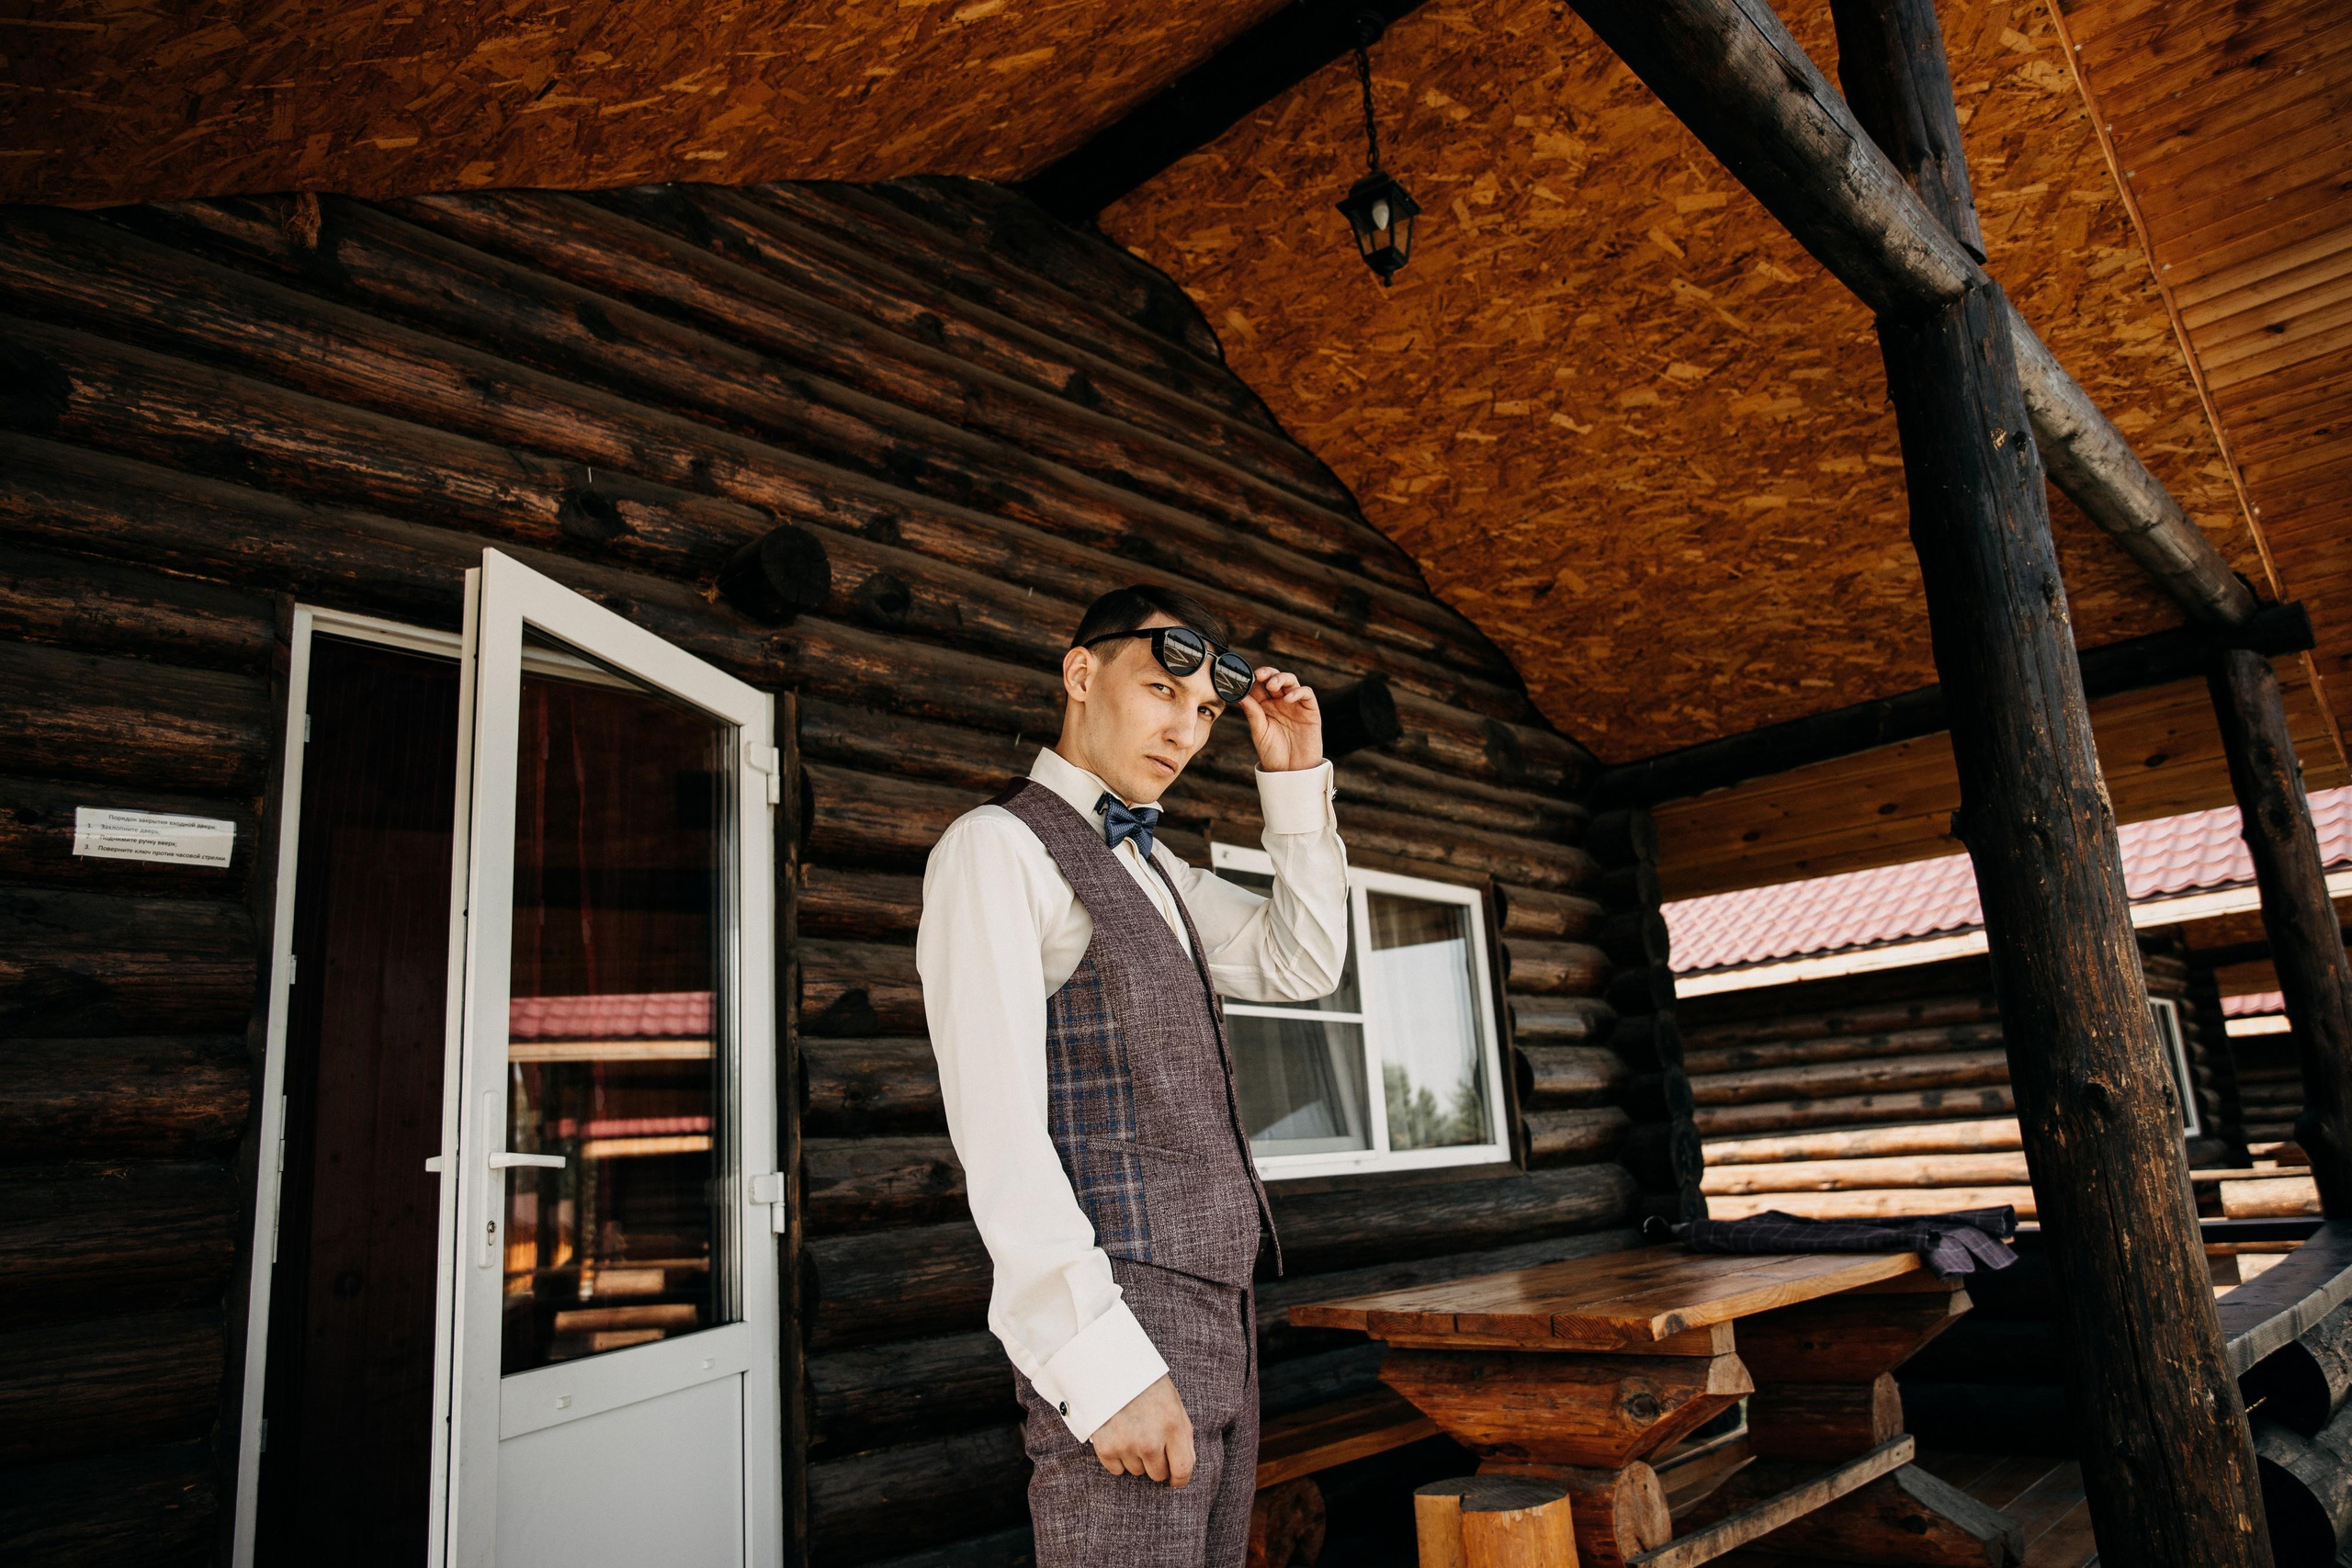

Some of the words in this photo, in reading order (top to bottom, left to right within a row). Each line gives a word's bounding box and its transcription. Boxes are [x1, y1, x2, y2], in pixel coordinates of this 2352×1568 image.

[108, 814, 138, 822] Порядок
[100, 823, 139, 832] Захлопните
[99, 834, 138, 843] Поднимите
[97, 844, 134, 853] Поверните
